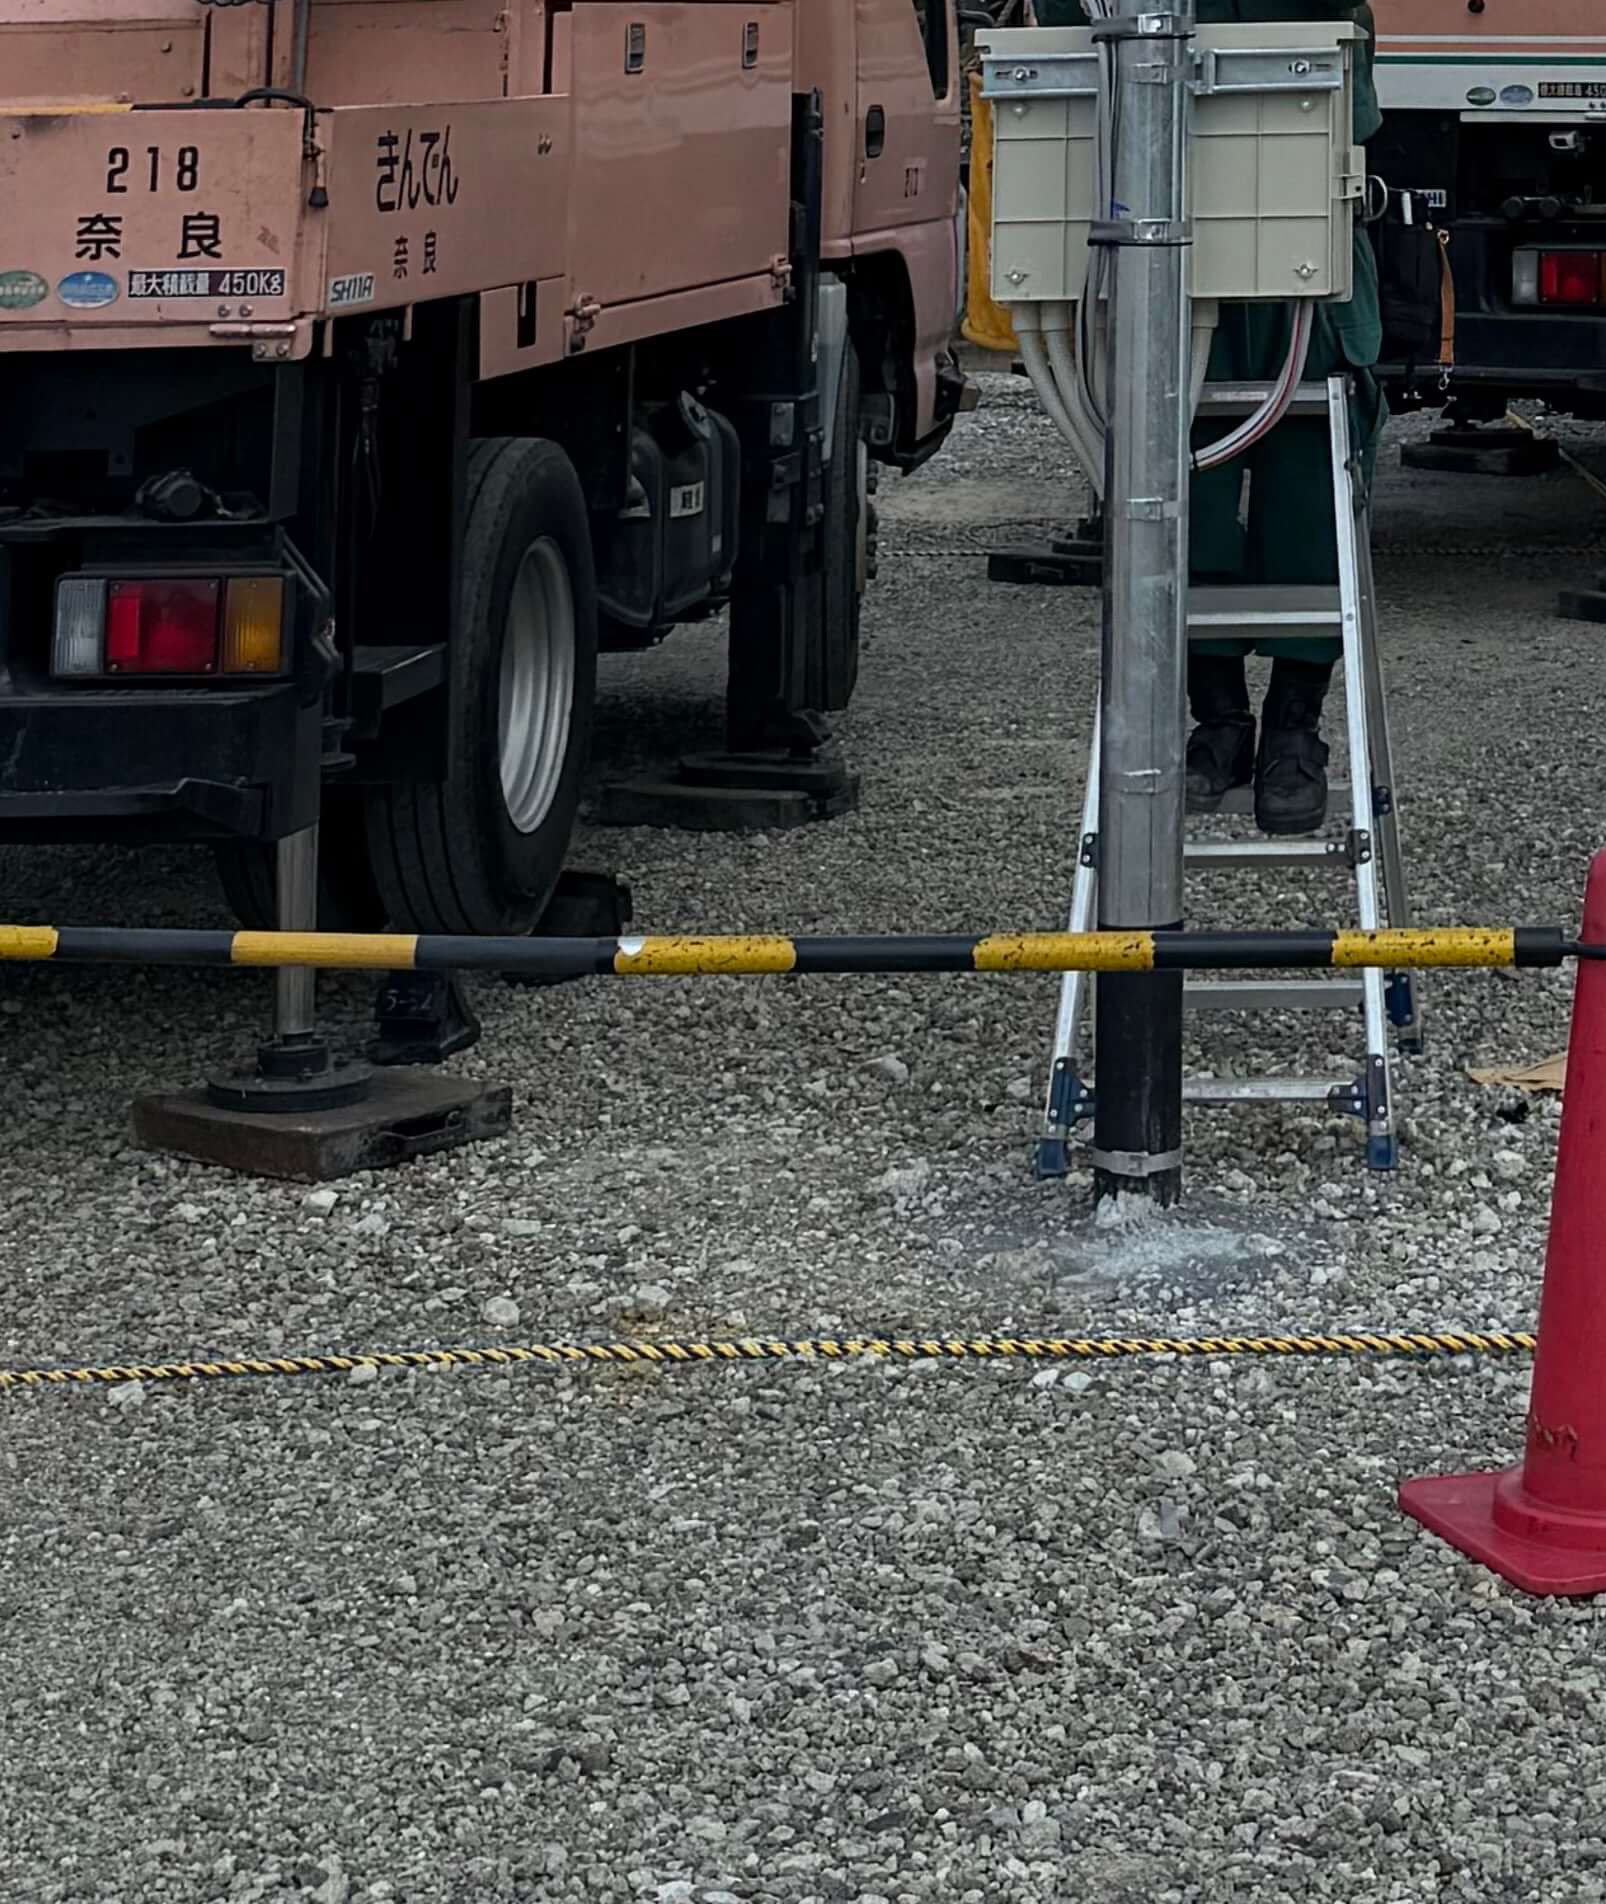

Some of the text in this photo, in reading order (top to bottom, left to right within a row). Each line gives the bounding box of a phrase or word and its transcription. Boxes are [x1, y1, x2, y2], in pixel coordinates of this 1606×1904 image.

[106, 145, 199, 193] 218
[376, 123, 459, 212] きんでん
[74, 210, 223, 261] 奈良
[393, 228, 438, 280] 奈良
[218, 271, 283, 296] 450Kg
